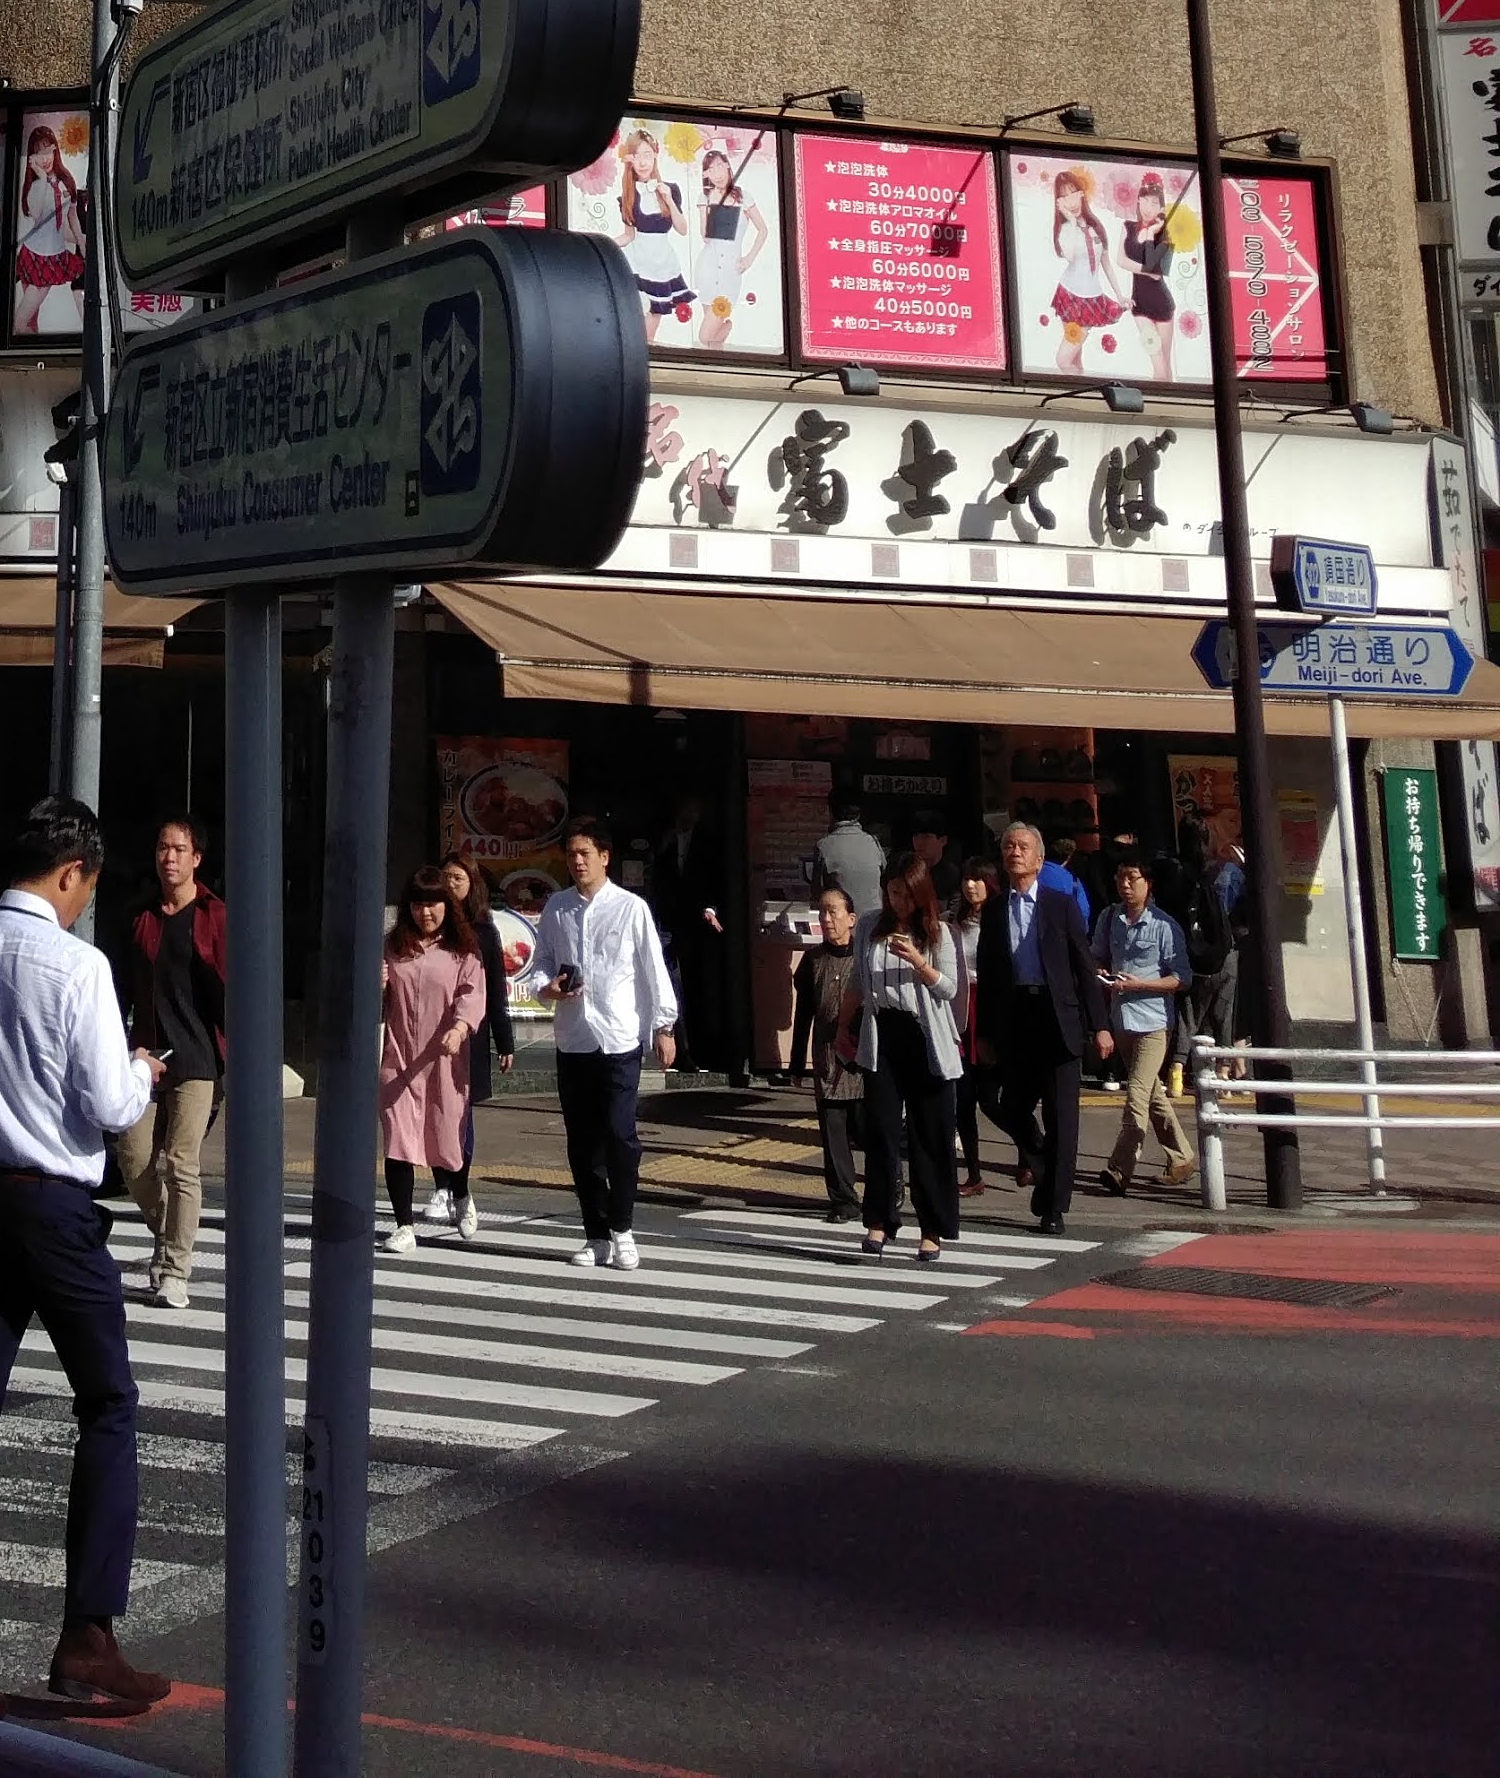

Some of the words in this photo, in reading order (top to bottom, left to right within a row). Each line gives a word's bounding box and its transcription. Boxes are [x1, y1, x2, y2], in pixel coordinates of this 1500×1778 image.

[369, 100, 413, 146] Center
[836, 160, 889, 178] 泡泡洗体
[867, 181, 967, 205] 30分4000円
[839, 198, 958, 221] 泡泡洗体アロマオイル
[870, 219, 968, 243] 60分7000円
[841, 237, 951, 259] 全身指圧マッサージ
[872, 258, 971, 282] 60分6000円
[1277, 193, 1305, 362] リラクゼーションサロン
[842, 275, 953, 297] 泡泡洗体マッサージ
[874, 297, 973, 319] 40分5000円
[844, 316, 958, 337] 他のコースもあります
[781, 408, 1178, 531] 富士そば
[330, 453, 391, 514] Center
[1292, 632, 1433, 667] 明治通り
[1297, 664, 1385, 687] Meiji-dori
[1390, 667, 1428, 687] Ave.
[1403, 777, 1431, 952] お持ち帰りできます
